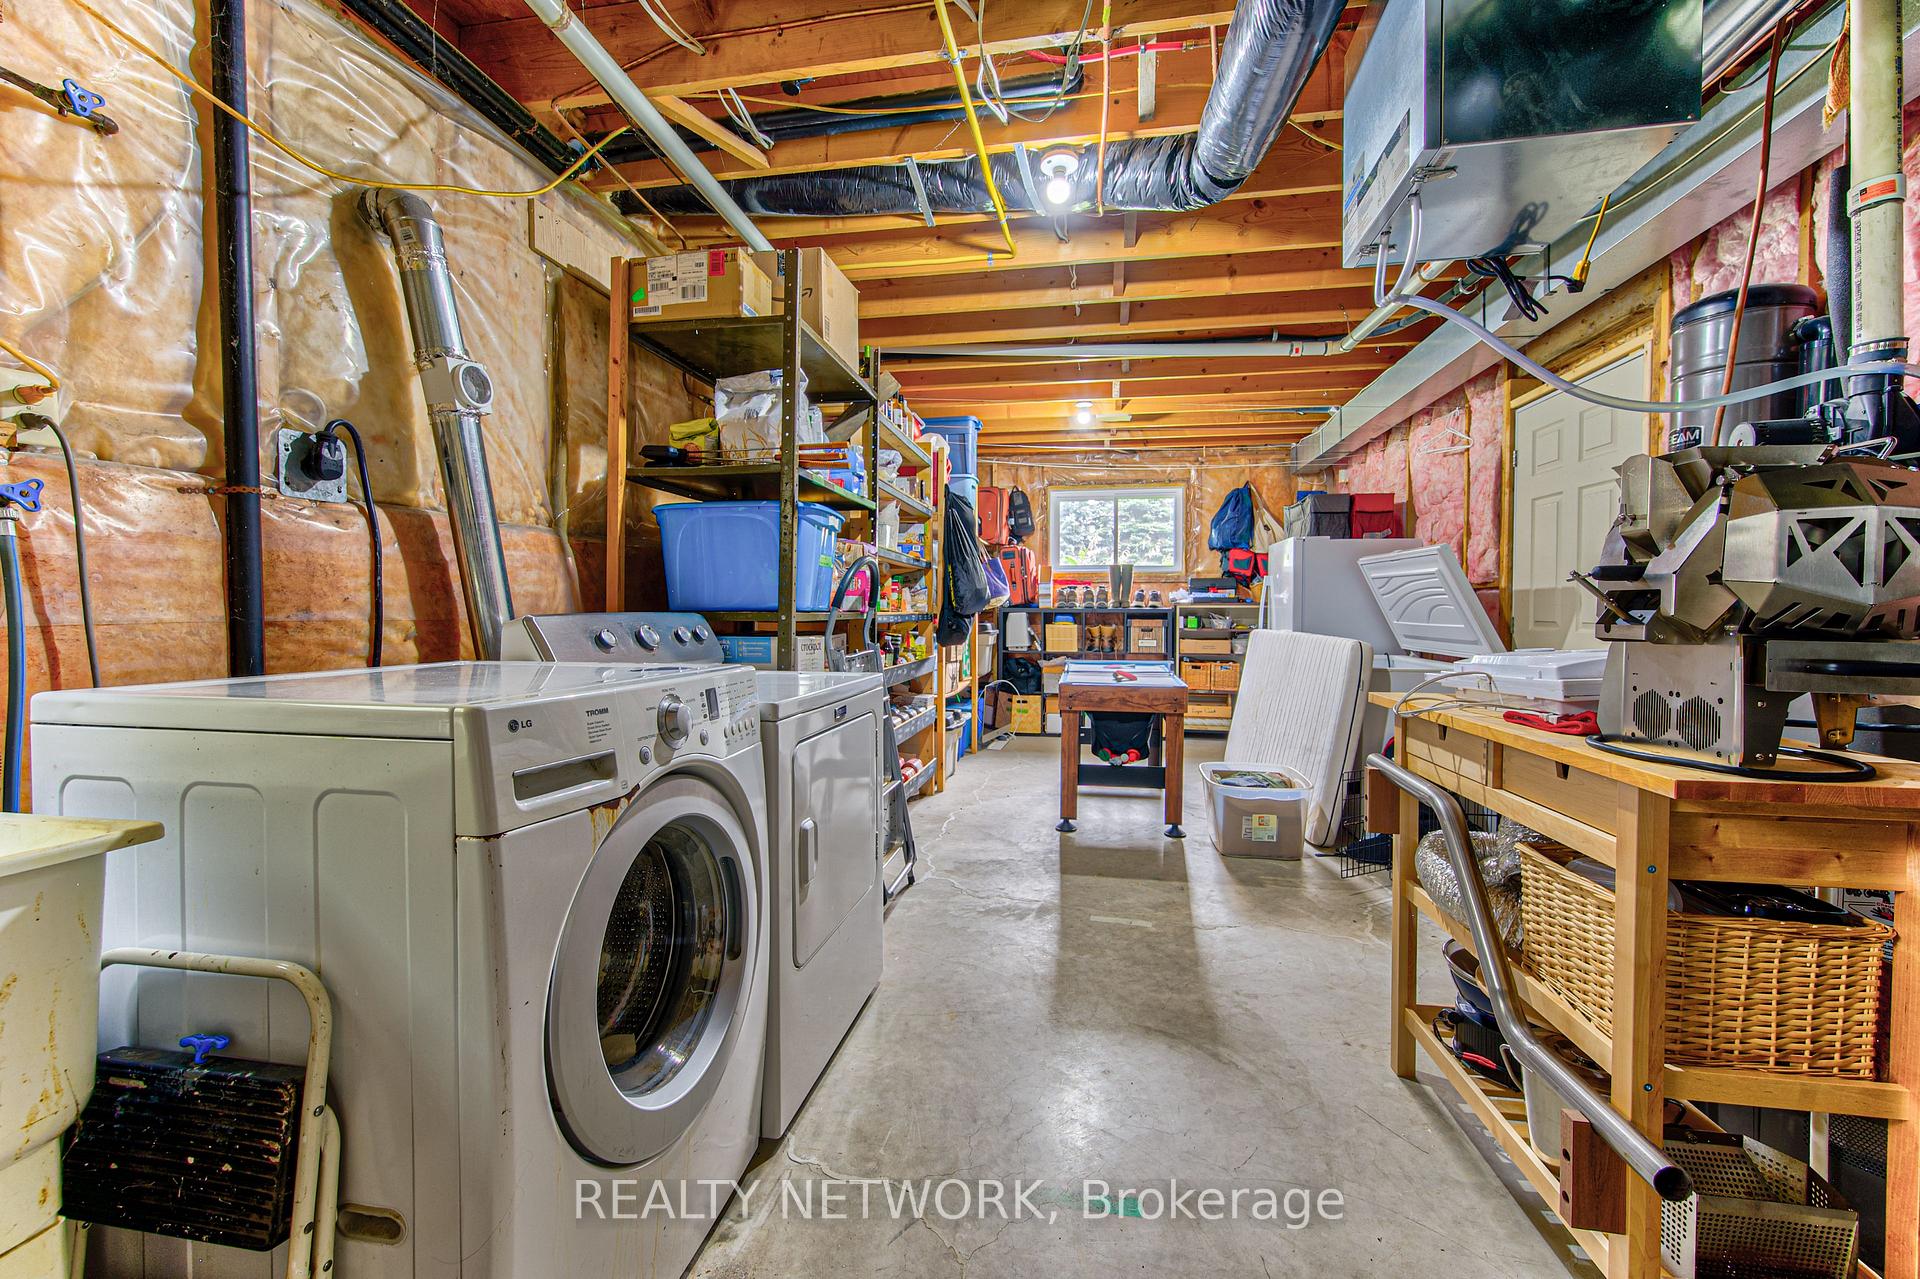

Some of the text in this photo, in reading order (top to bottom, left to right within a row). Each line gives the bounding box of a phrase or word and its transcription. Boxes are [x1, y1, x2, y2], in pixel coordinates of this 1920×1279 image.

[1669, 430, 1700, 445] EAM
[585, 707, 609, 717] TROMM
[520, 719, 533, 729] LG
